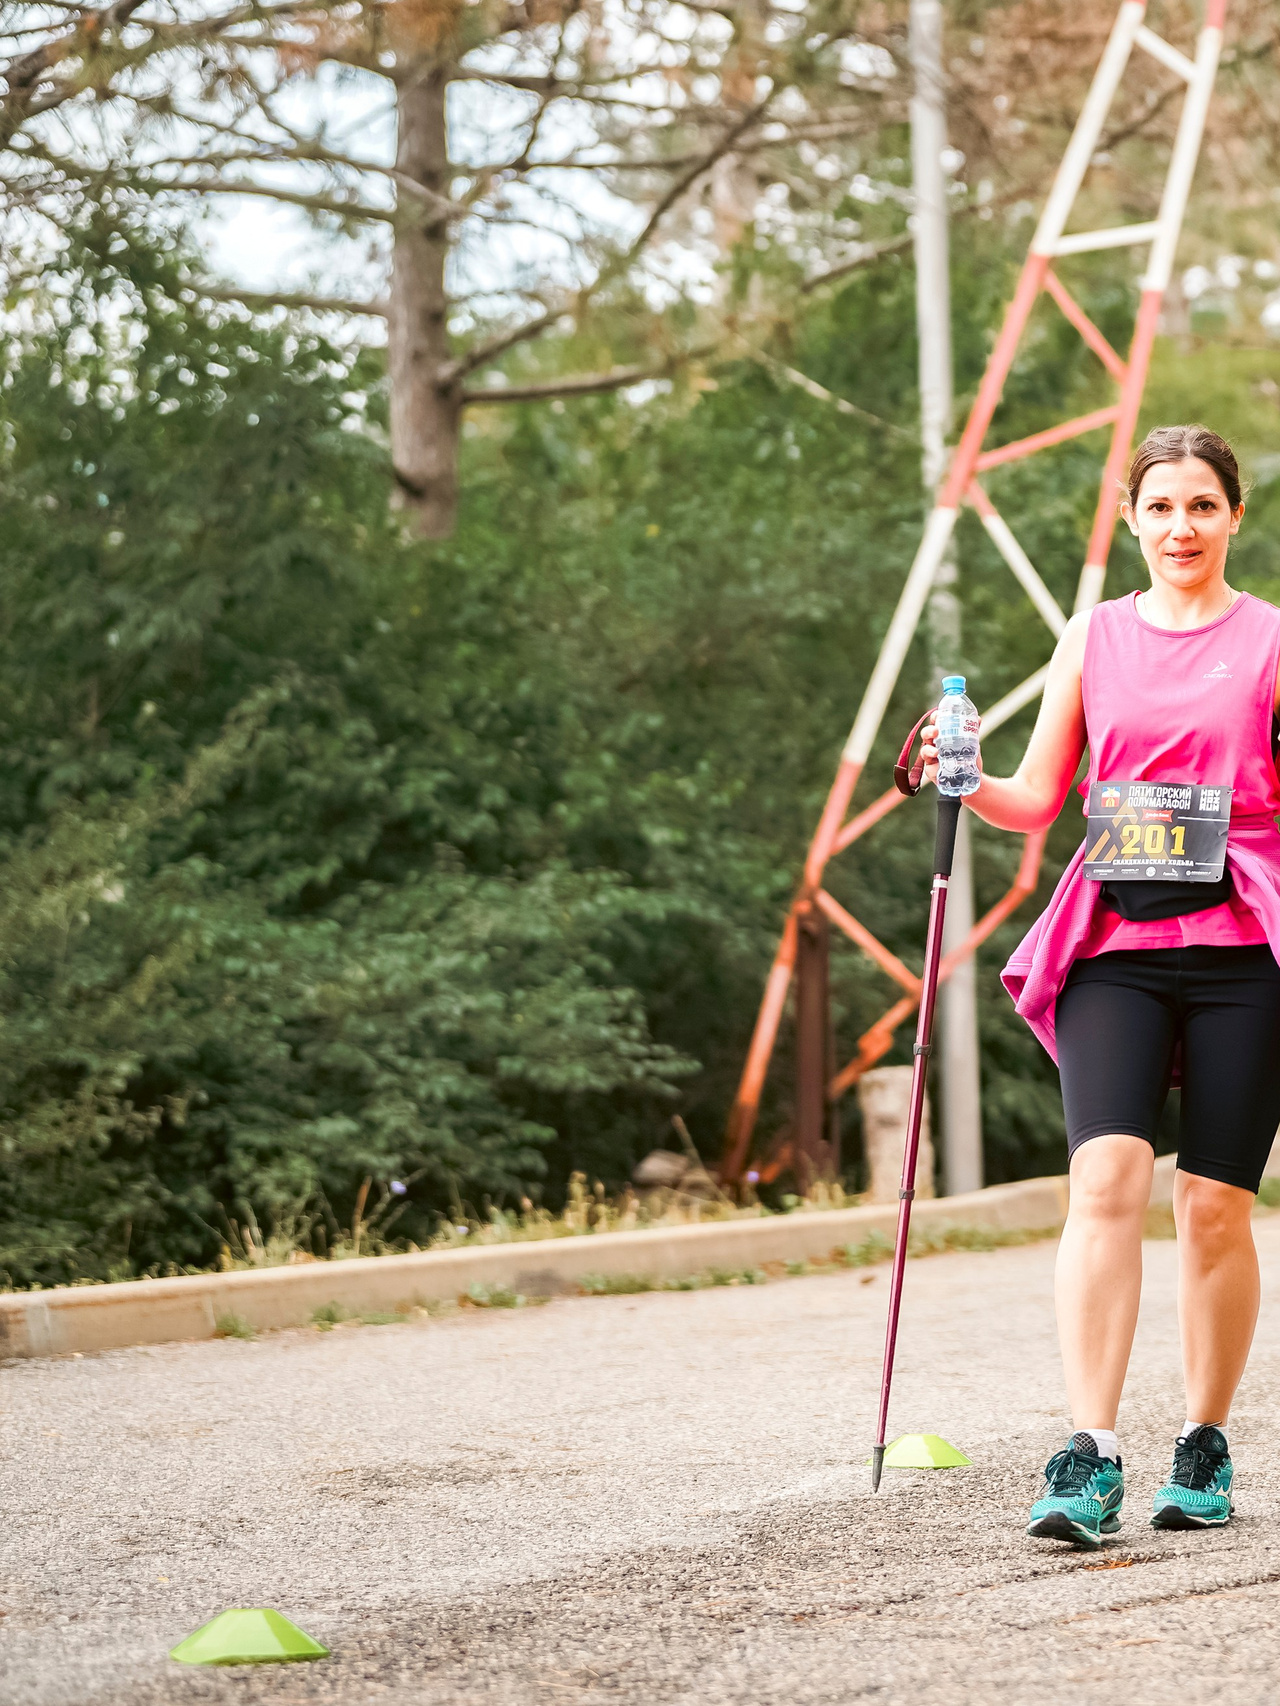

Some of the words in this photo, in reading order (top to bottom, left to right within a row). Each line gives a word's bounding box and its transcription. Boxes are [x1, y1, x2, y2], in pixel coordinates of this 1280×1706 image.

[1128, 786, 1192, 800] ПЯТИГОРСКИЙ
[1127, 797, 1191, 811] ПОЛУМАРАФОН
[1120, 824, 1186, 856] 201
